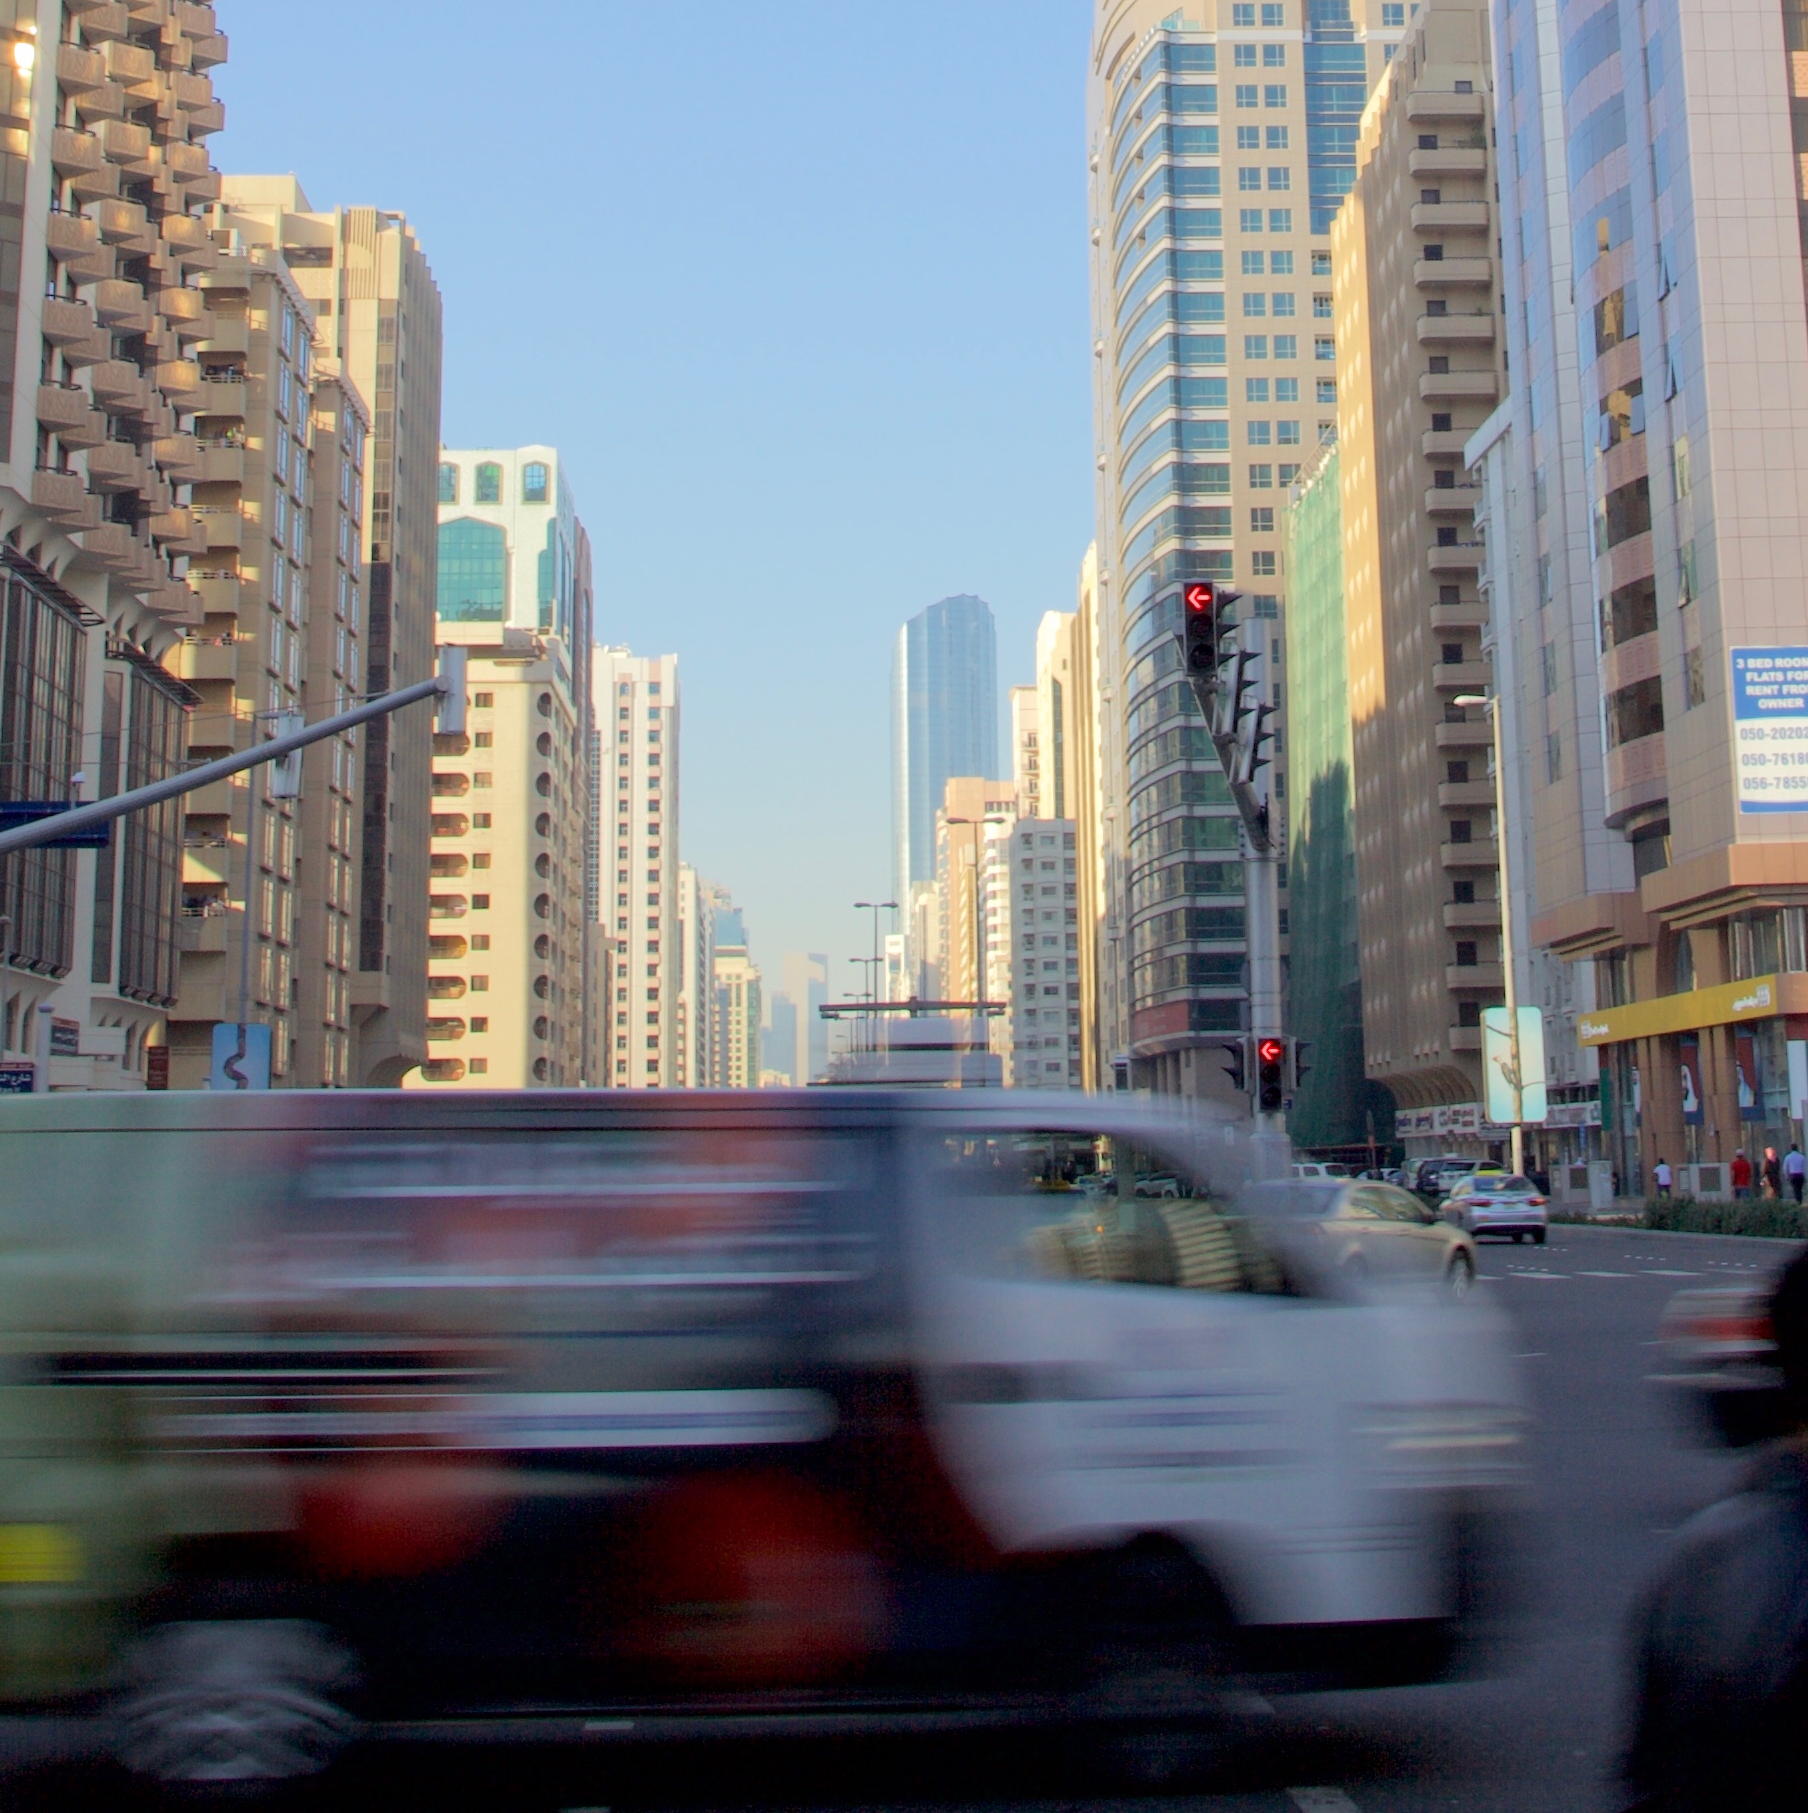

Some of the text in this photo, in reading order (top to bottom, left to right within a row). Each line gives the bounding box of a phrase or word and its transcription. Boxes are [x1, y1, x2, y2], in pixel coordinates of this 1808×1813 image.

[1736, 658, 1745, 669] 3
[1747, 658, 1773, 669] BED
[1745, 671, 1785, 682] FLATS
[1745, 685, 1780, 696] RENT
[1758, 698, 1805, 709] OWNER
